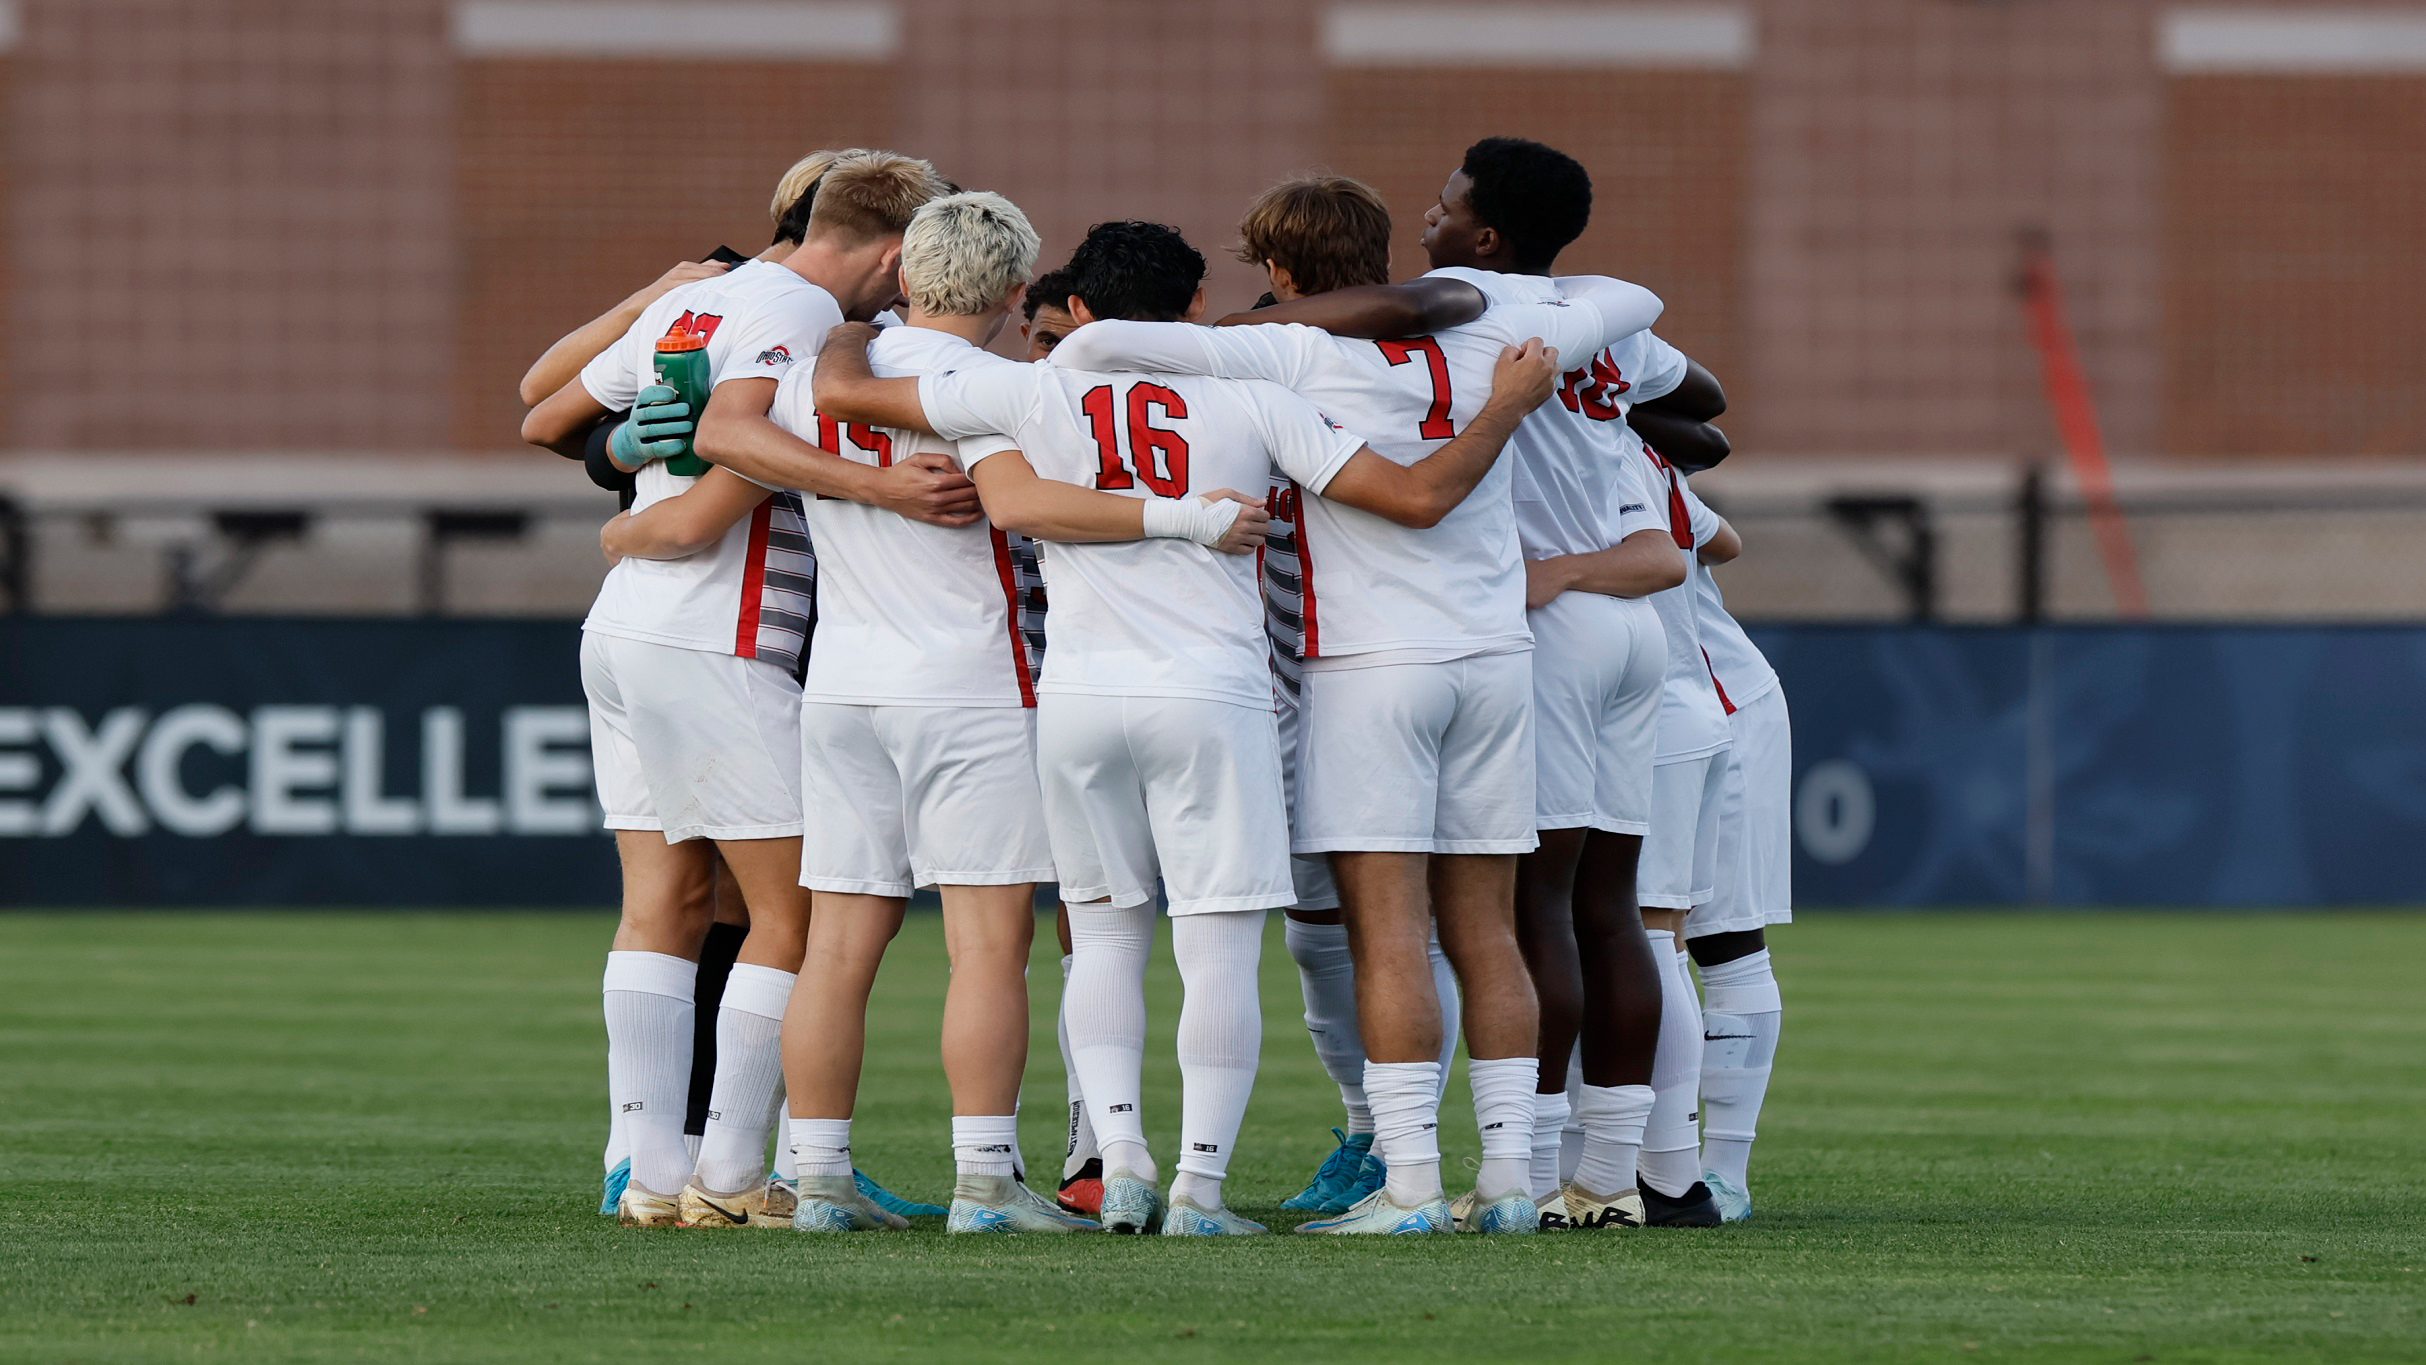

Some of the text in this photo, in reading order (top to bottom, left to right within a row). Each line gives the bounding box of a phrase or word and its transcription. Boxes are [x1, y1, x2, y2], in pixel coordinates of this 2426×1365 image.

[755, 350, 793, 366] OHIO STAT
[1373, 336, 1456, 440] 7
[1082, 381, 1189, 500] 16
